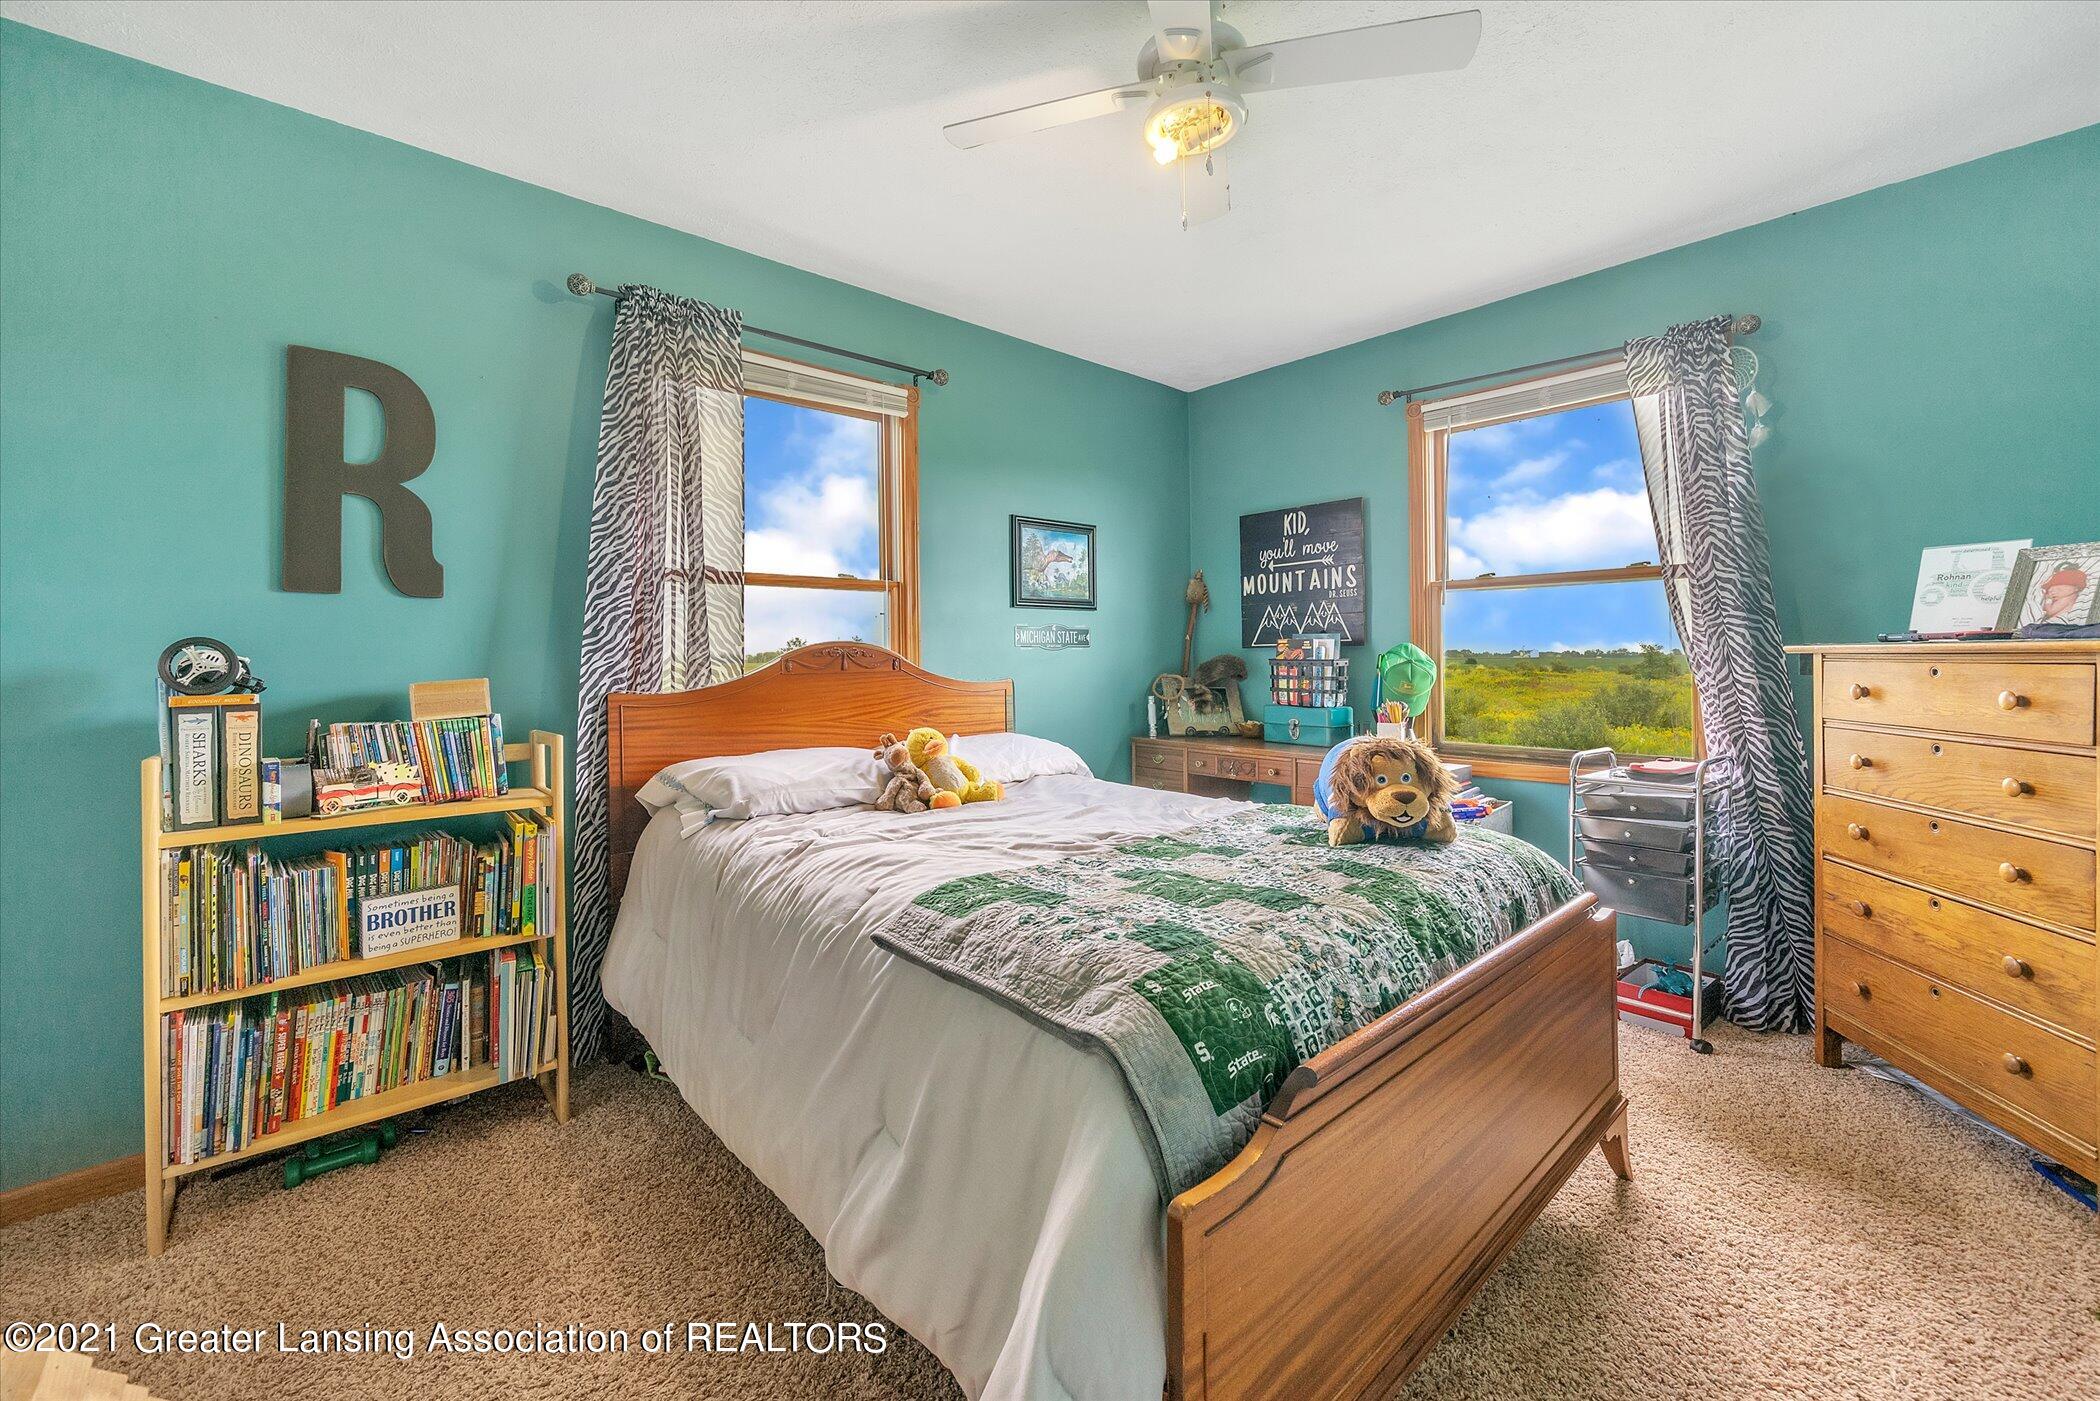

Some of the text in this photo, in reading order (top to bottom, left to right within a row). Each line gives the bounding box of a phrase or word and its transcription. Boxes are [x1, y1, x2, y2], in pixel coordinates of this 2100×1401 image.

[281, 343, 444, 599] R
[1283, 510, 1310, 536] KID,
[1259, 537, 1339, 569] you'll move
[1243, 564, 1357, 597] MOUNTAINS
[1937, 573, 1971, 581] Rohnan
[1339, 588, 1358, 598] SEUSS
[1020, 629, 1056, 644] MICHIGAN
[1057, 630, 1078, 644] STATE
[192, 732, 207, 787] SHARKS
[238, 732, 252, 811] DINOSAURS
[367, 897, 419, 913] Sometimes
[422, 892, 447, 904] being
[367, 900, 456, 932] BROTHER
[368, 919, 457, 942] is even better than
[368, 942, 391, 953] being
[400, 927, 457, 947] SUPERHERO!
[445, 989, 455, 1003] 365
[274, 1031, 286, 1075] SUPER HEROES
